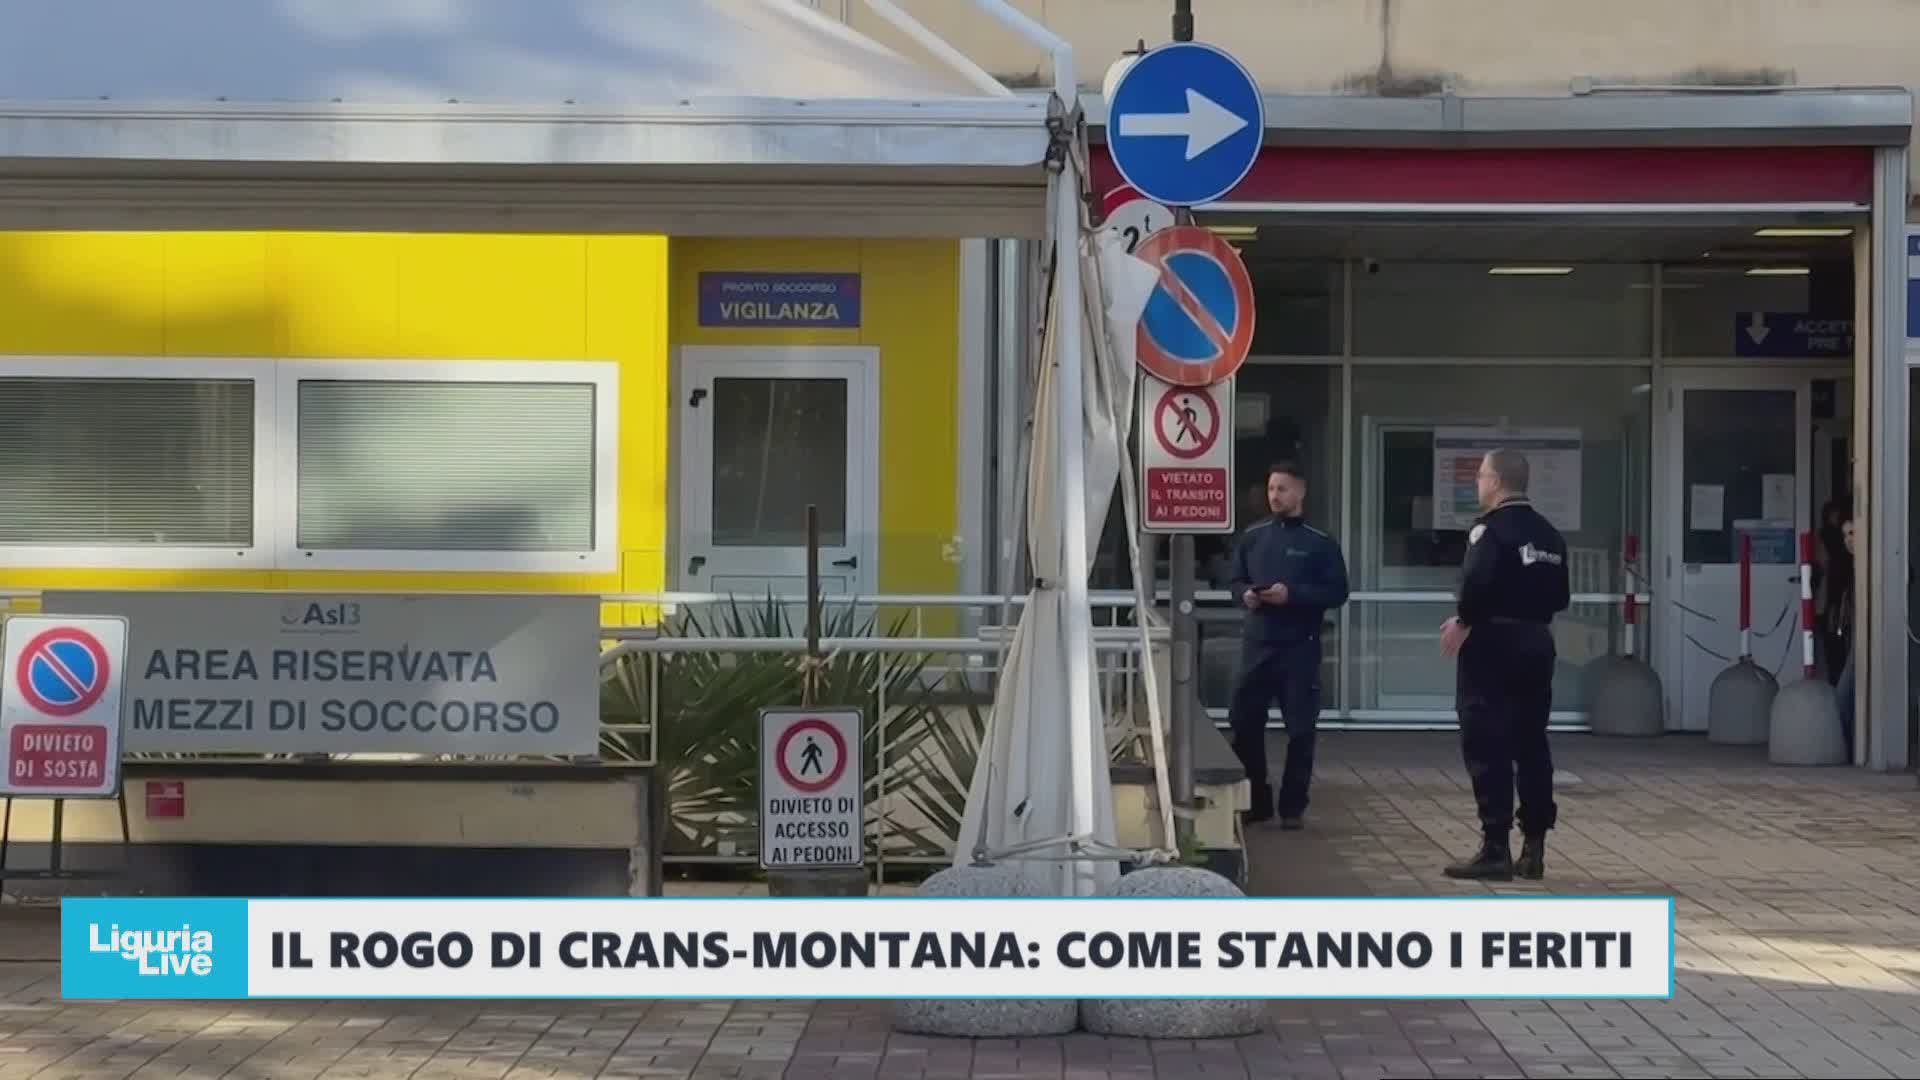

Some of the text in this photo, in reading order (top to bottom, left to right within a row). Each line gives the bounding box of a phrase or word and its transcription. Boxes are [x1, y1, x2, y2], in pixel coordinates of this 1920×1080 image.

[719, 302, 840, 320] VIGILANZA
[1160, 473, 1213, 484] VIETATO
[1151, 489, 1224, 500] IL TRANSITO
[1155, 505, 1220, 518] AI PEDONI
[144, 648, 497, 682] AREA RISERVATA
[133, 698, 560, 734] MEZZI DI SOCCORSO
[23, 734, 94, 752] DIVIETO
[15, 759, 98, 778] DI SOSTA
[770, 798, 853, 815] DIVIETO DI
[775, 821, 849, 839] ACCESSO
[772, 846, 853, 862] AI PEDONI
